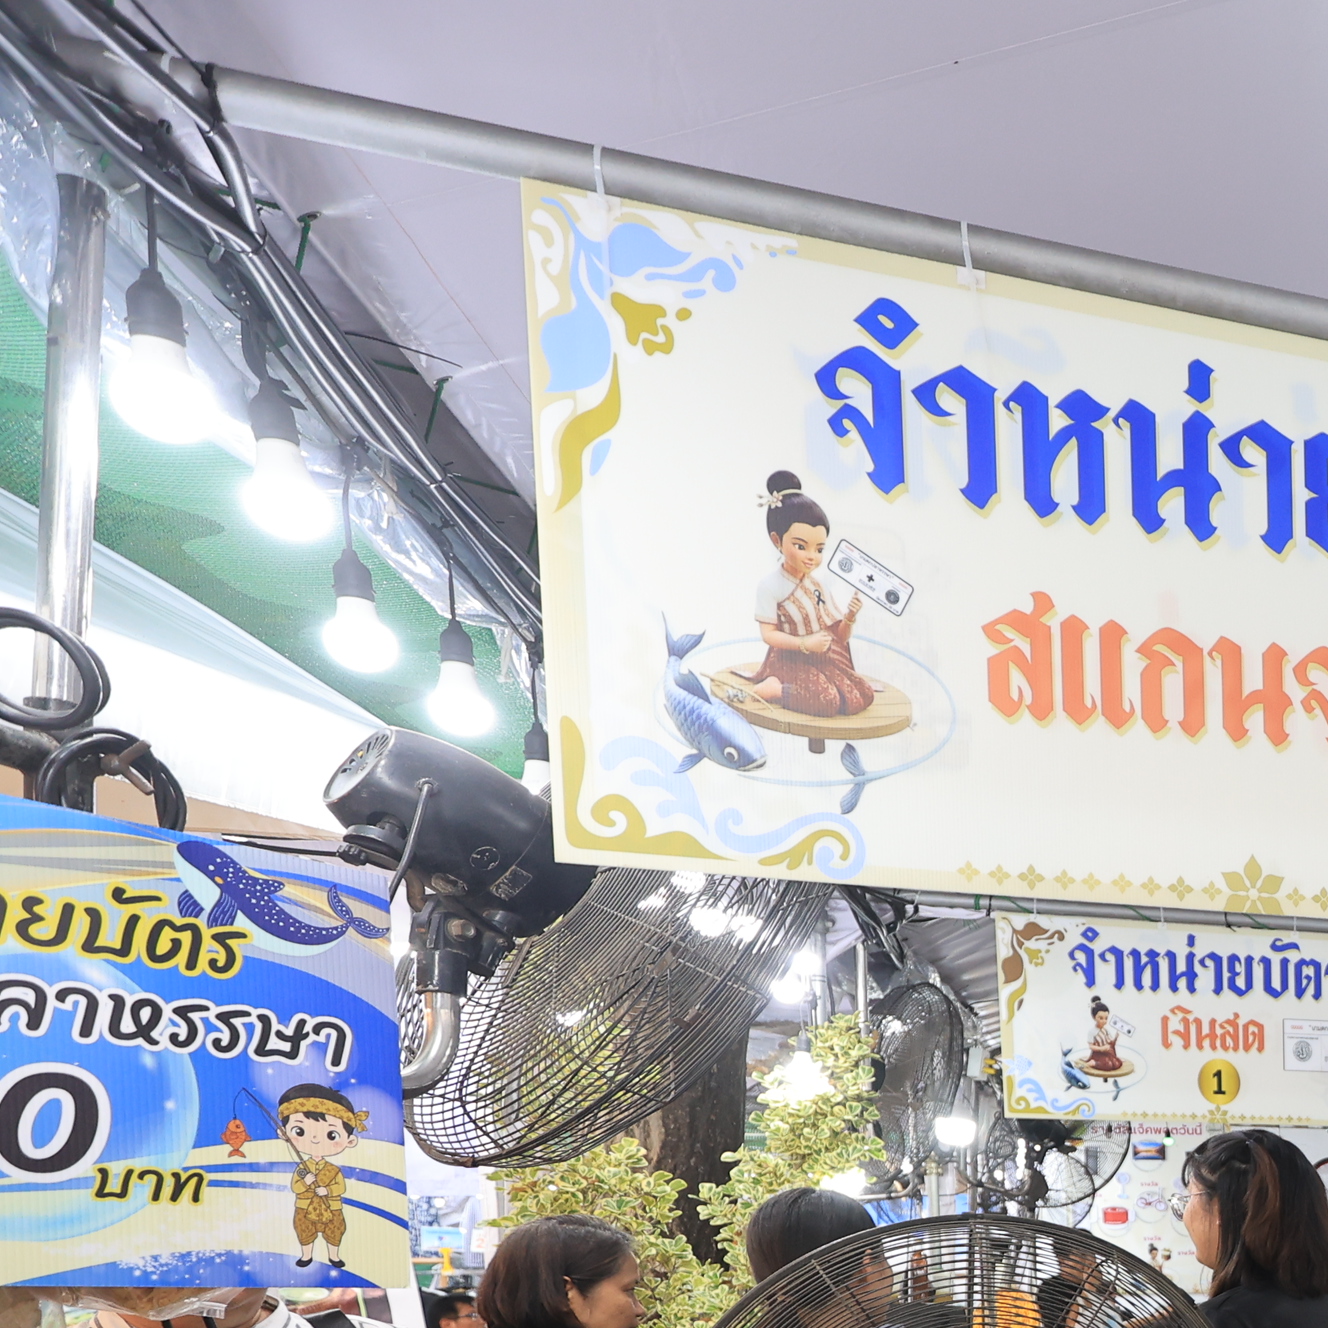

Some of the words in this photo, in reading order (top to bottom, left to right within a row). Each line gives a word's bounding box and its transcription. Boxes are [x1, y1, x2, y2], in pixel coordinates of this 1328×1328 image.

[0, 886, 248, 974] ยบัตร
[1160, 1004, 1266, 1054] เงินสด
[1212, 1069, 1227, 1095] 1
[94, 1166, 205, 1204] บาท
